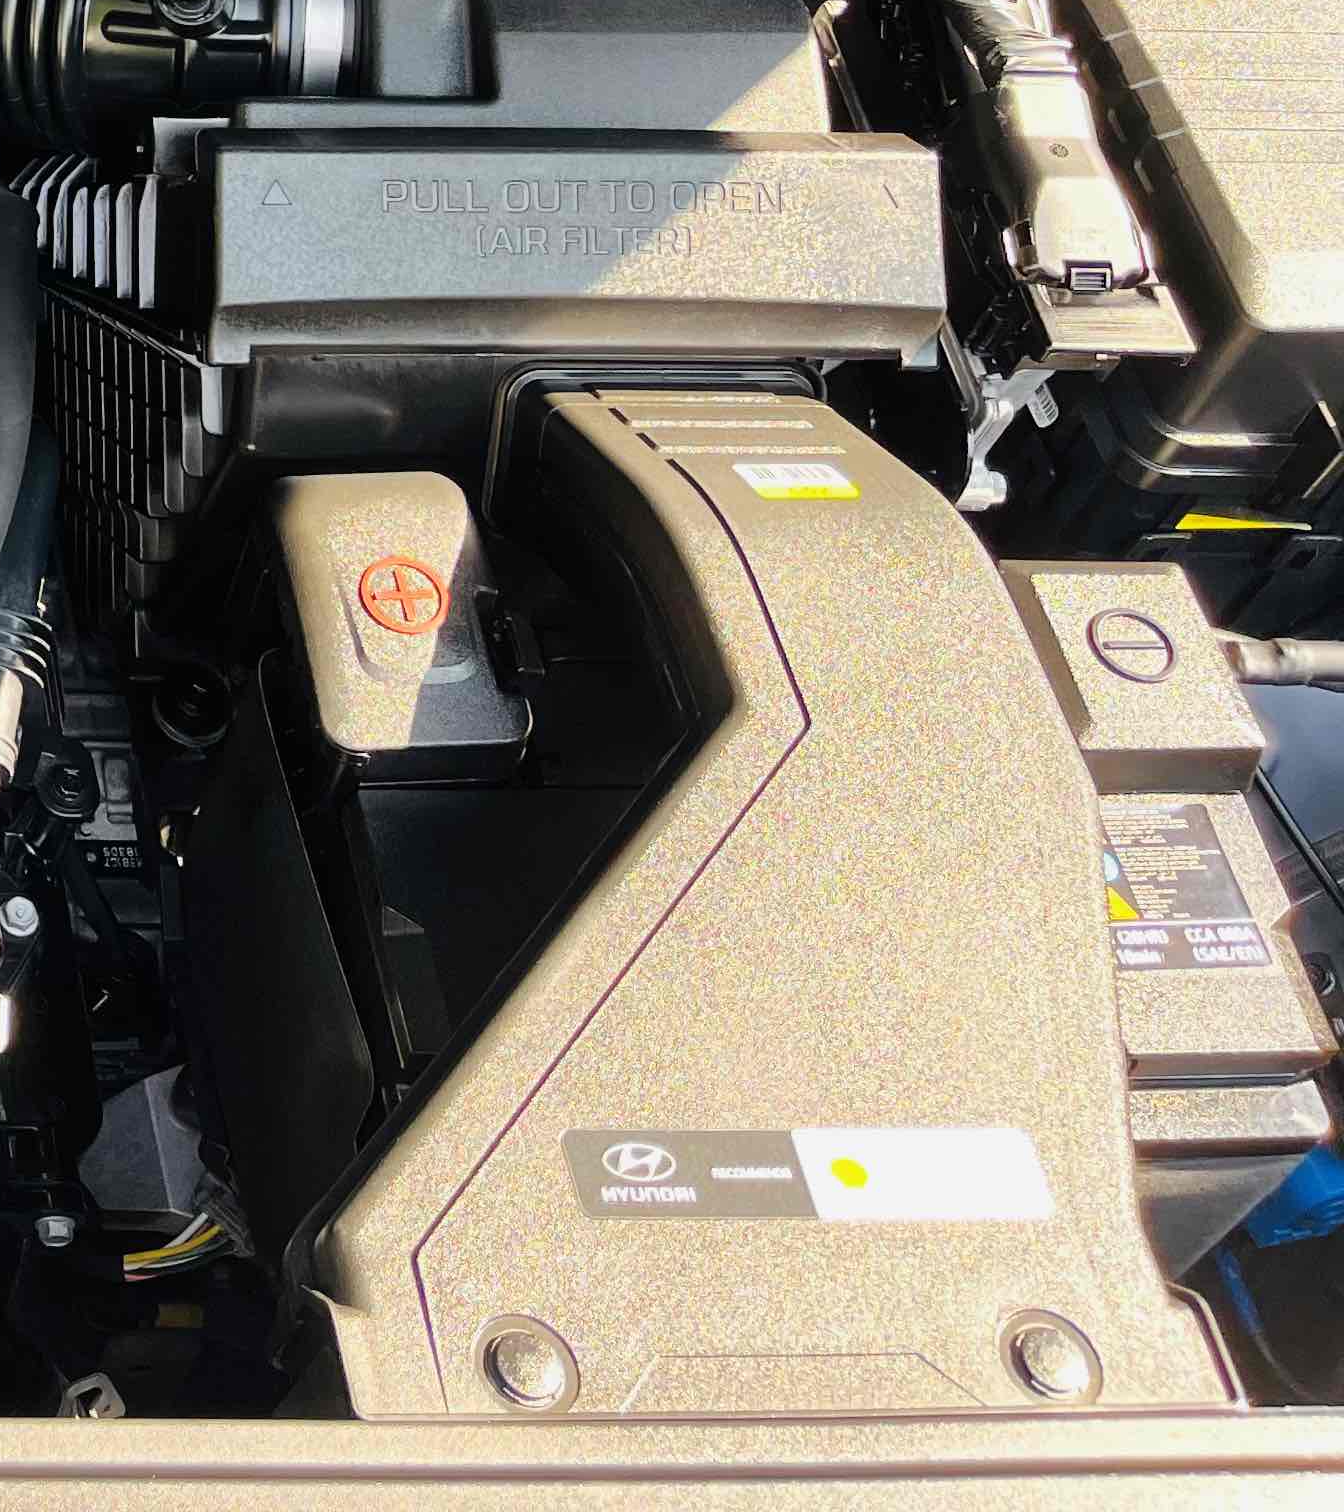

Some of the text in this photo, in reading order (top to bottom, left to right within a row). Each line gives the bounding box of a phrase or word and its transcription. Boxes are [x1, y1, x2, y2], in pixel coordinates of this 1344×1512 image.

[382, 179, 783, 215] PULL OUT TO OPEN
[476, 224, 693, 257] (AIR FILTER)
[601, 1186, 697, 1203] HYUNDAI
